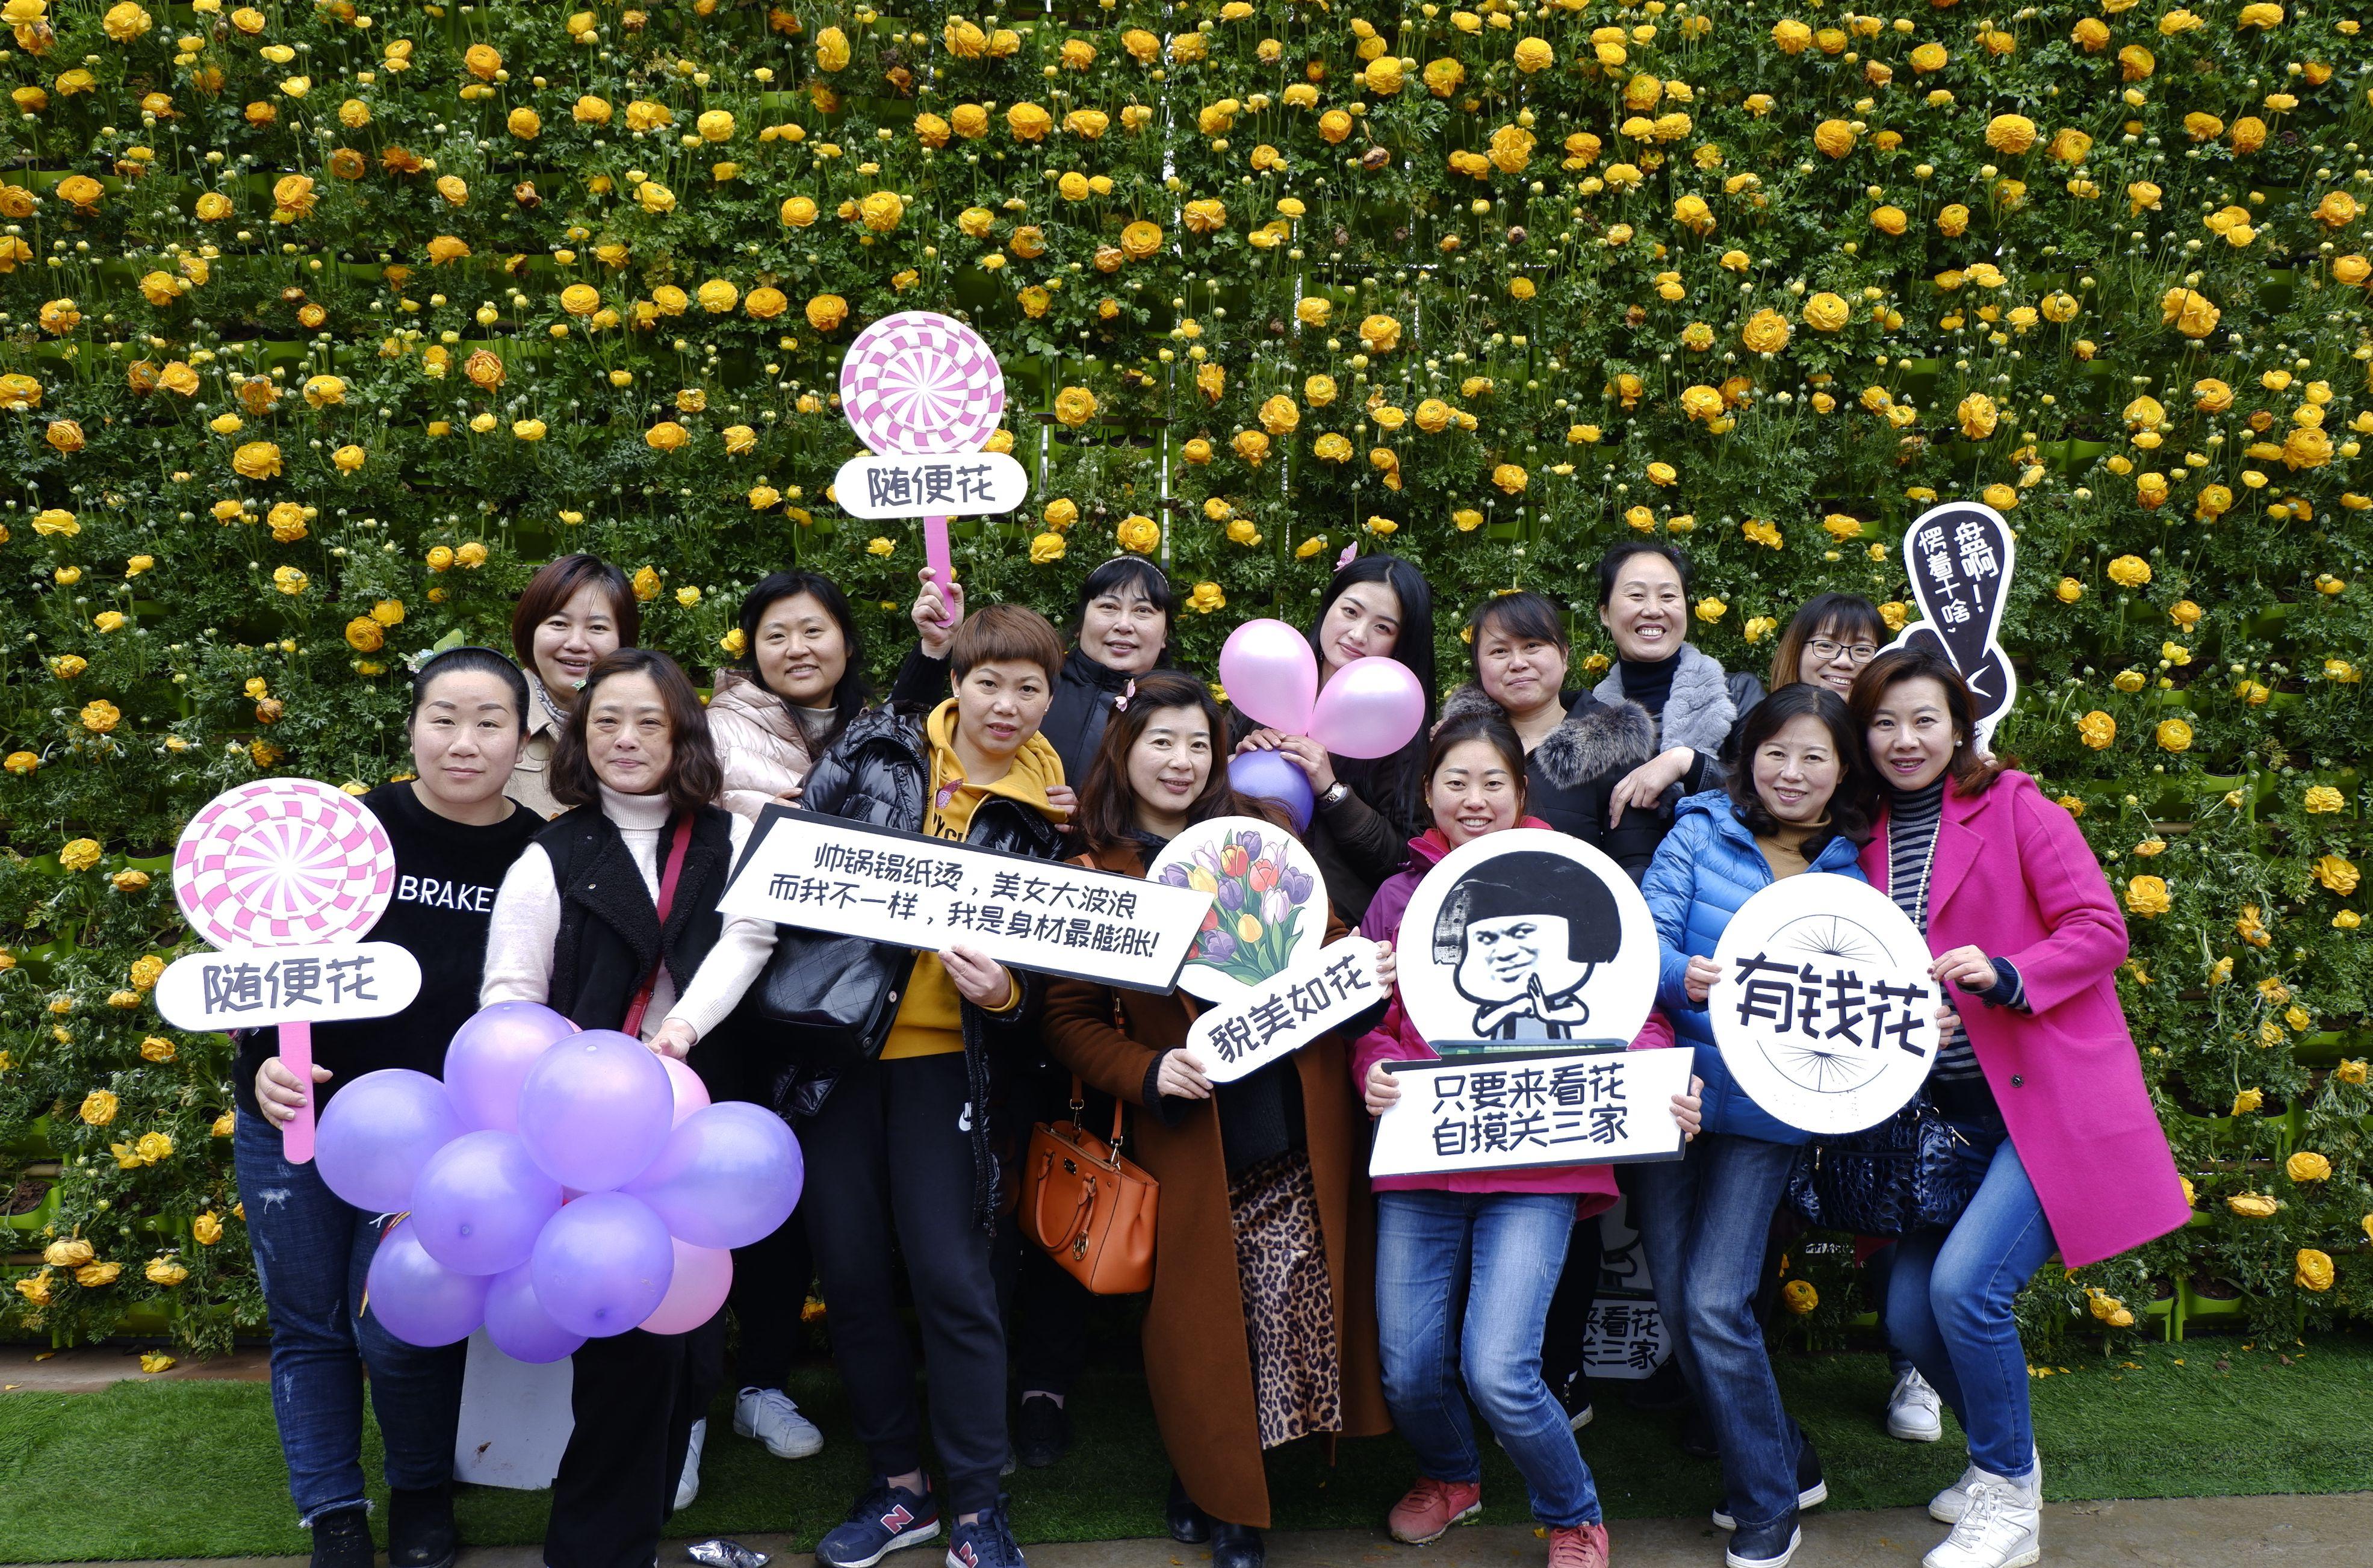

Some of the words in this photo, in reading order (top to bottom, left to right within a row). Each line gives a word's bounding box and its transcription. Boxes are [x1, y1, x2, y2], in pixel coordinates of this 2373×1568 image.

[867, 464, 996, 507] 随便花
[398, 875, 494, 912] BRAKE
[814, 842, 1137, 919] 帅锅锡纸烫，美女大波浪
[202, 956, 378, 1014] 随便花
[1735, 951, 1929, 1058] 有钱花
[1432, 1062, 1626, 1114] 只要来看花
[1432, 1103, 1628, 1156] 自摸关三家
